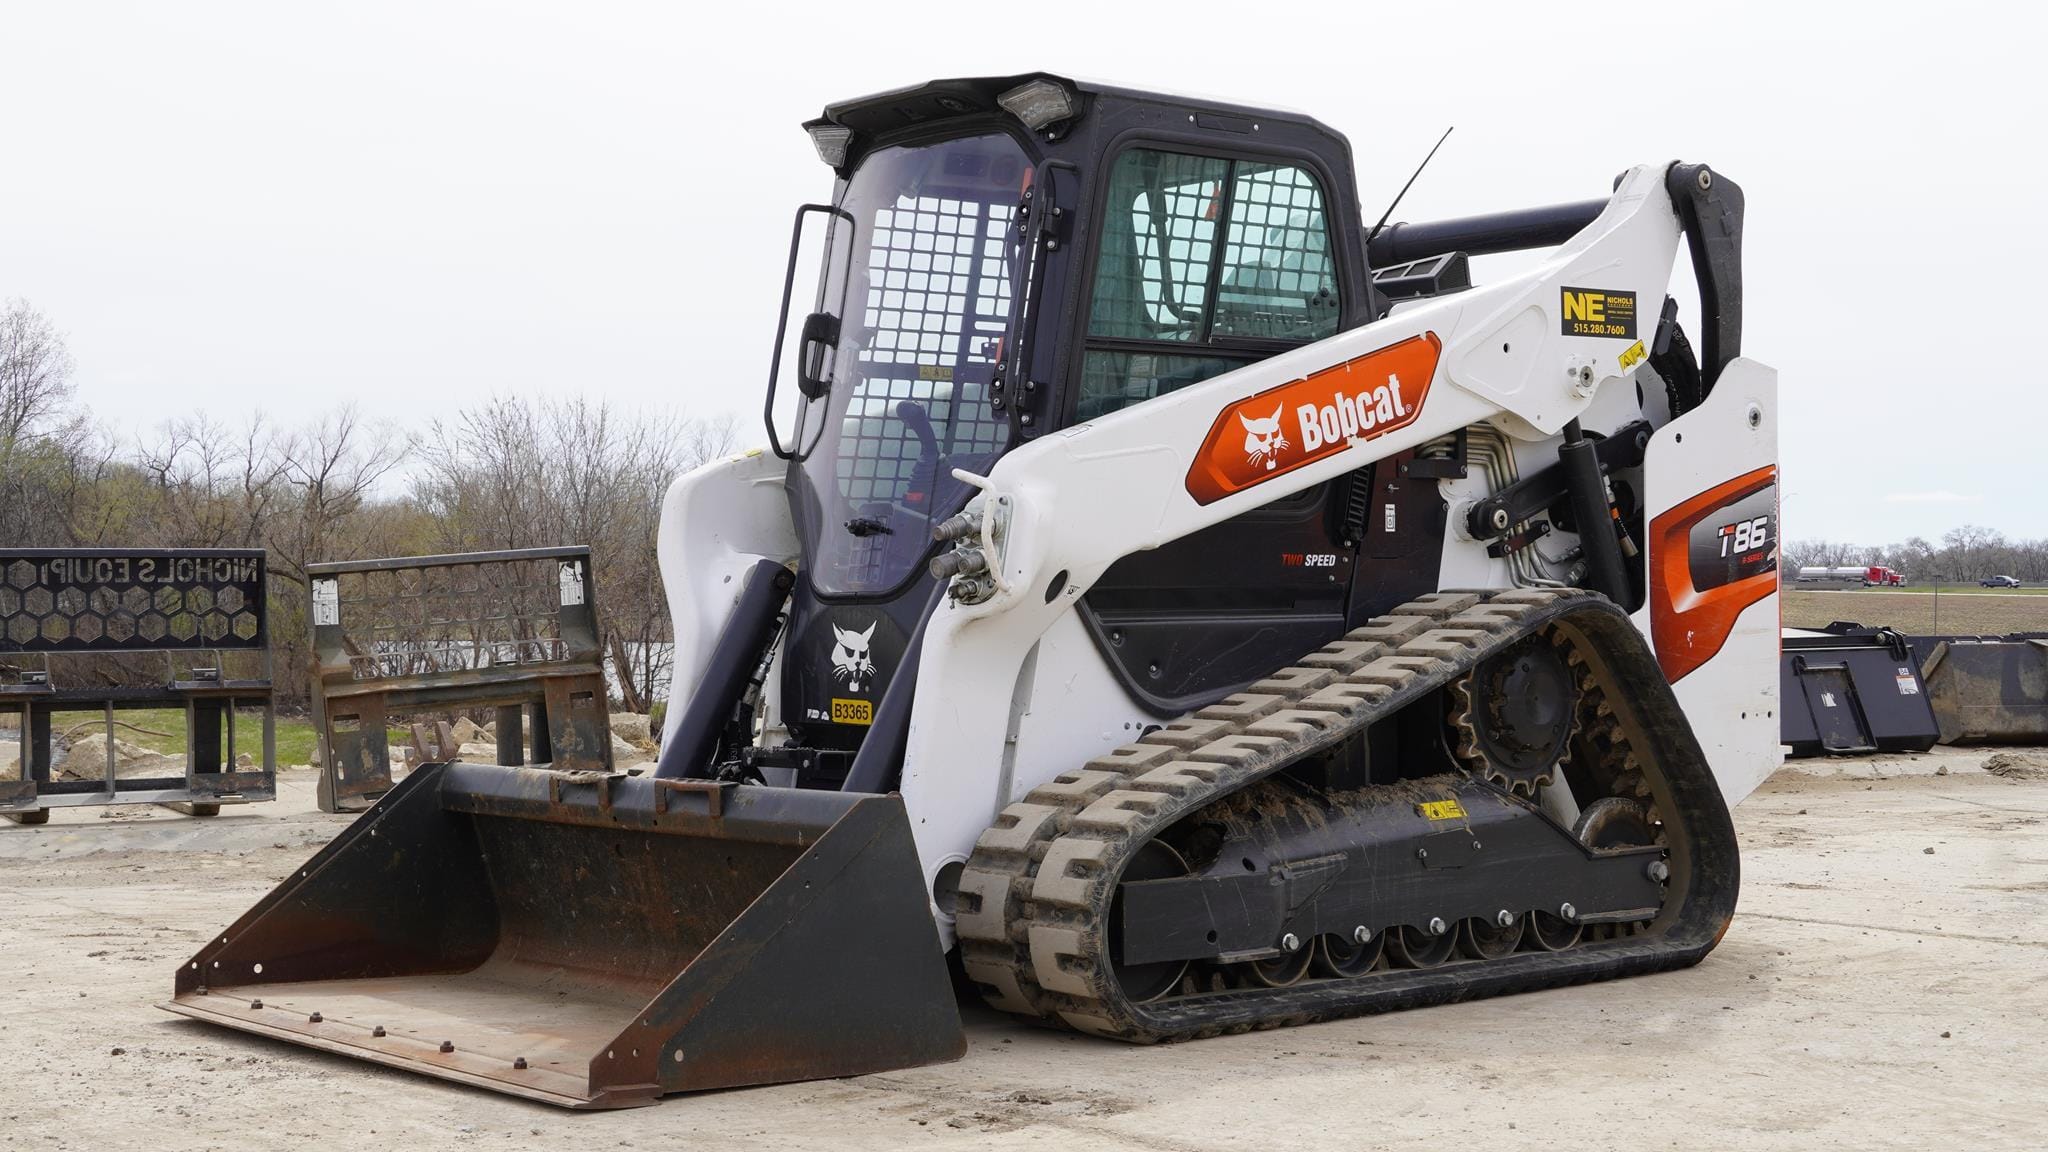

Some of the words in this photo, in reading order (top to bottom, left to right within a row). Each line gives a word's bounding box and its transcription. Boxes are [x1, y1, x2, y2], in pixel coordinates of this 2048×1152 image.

[1564, 291, 1605, 322] NE
[1607, 296, 1633, 304] NICHOLS
[1574, 323, 1625, 335] 515.280.7600
[1296, 373, 1406, 453] Bobcat
[1718, 516, 1768, 558] T86
[1281, 554, 1303, 567] TWO
[1305, 554, 1336, 567] SPEED
[834, 703, 868, 720] B3365
